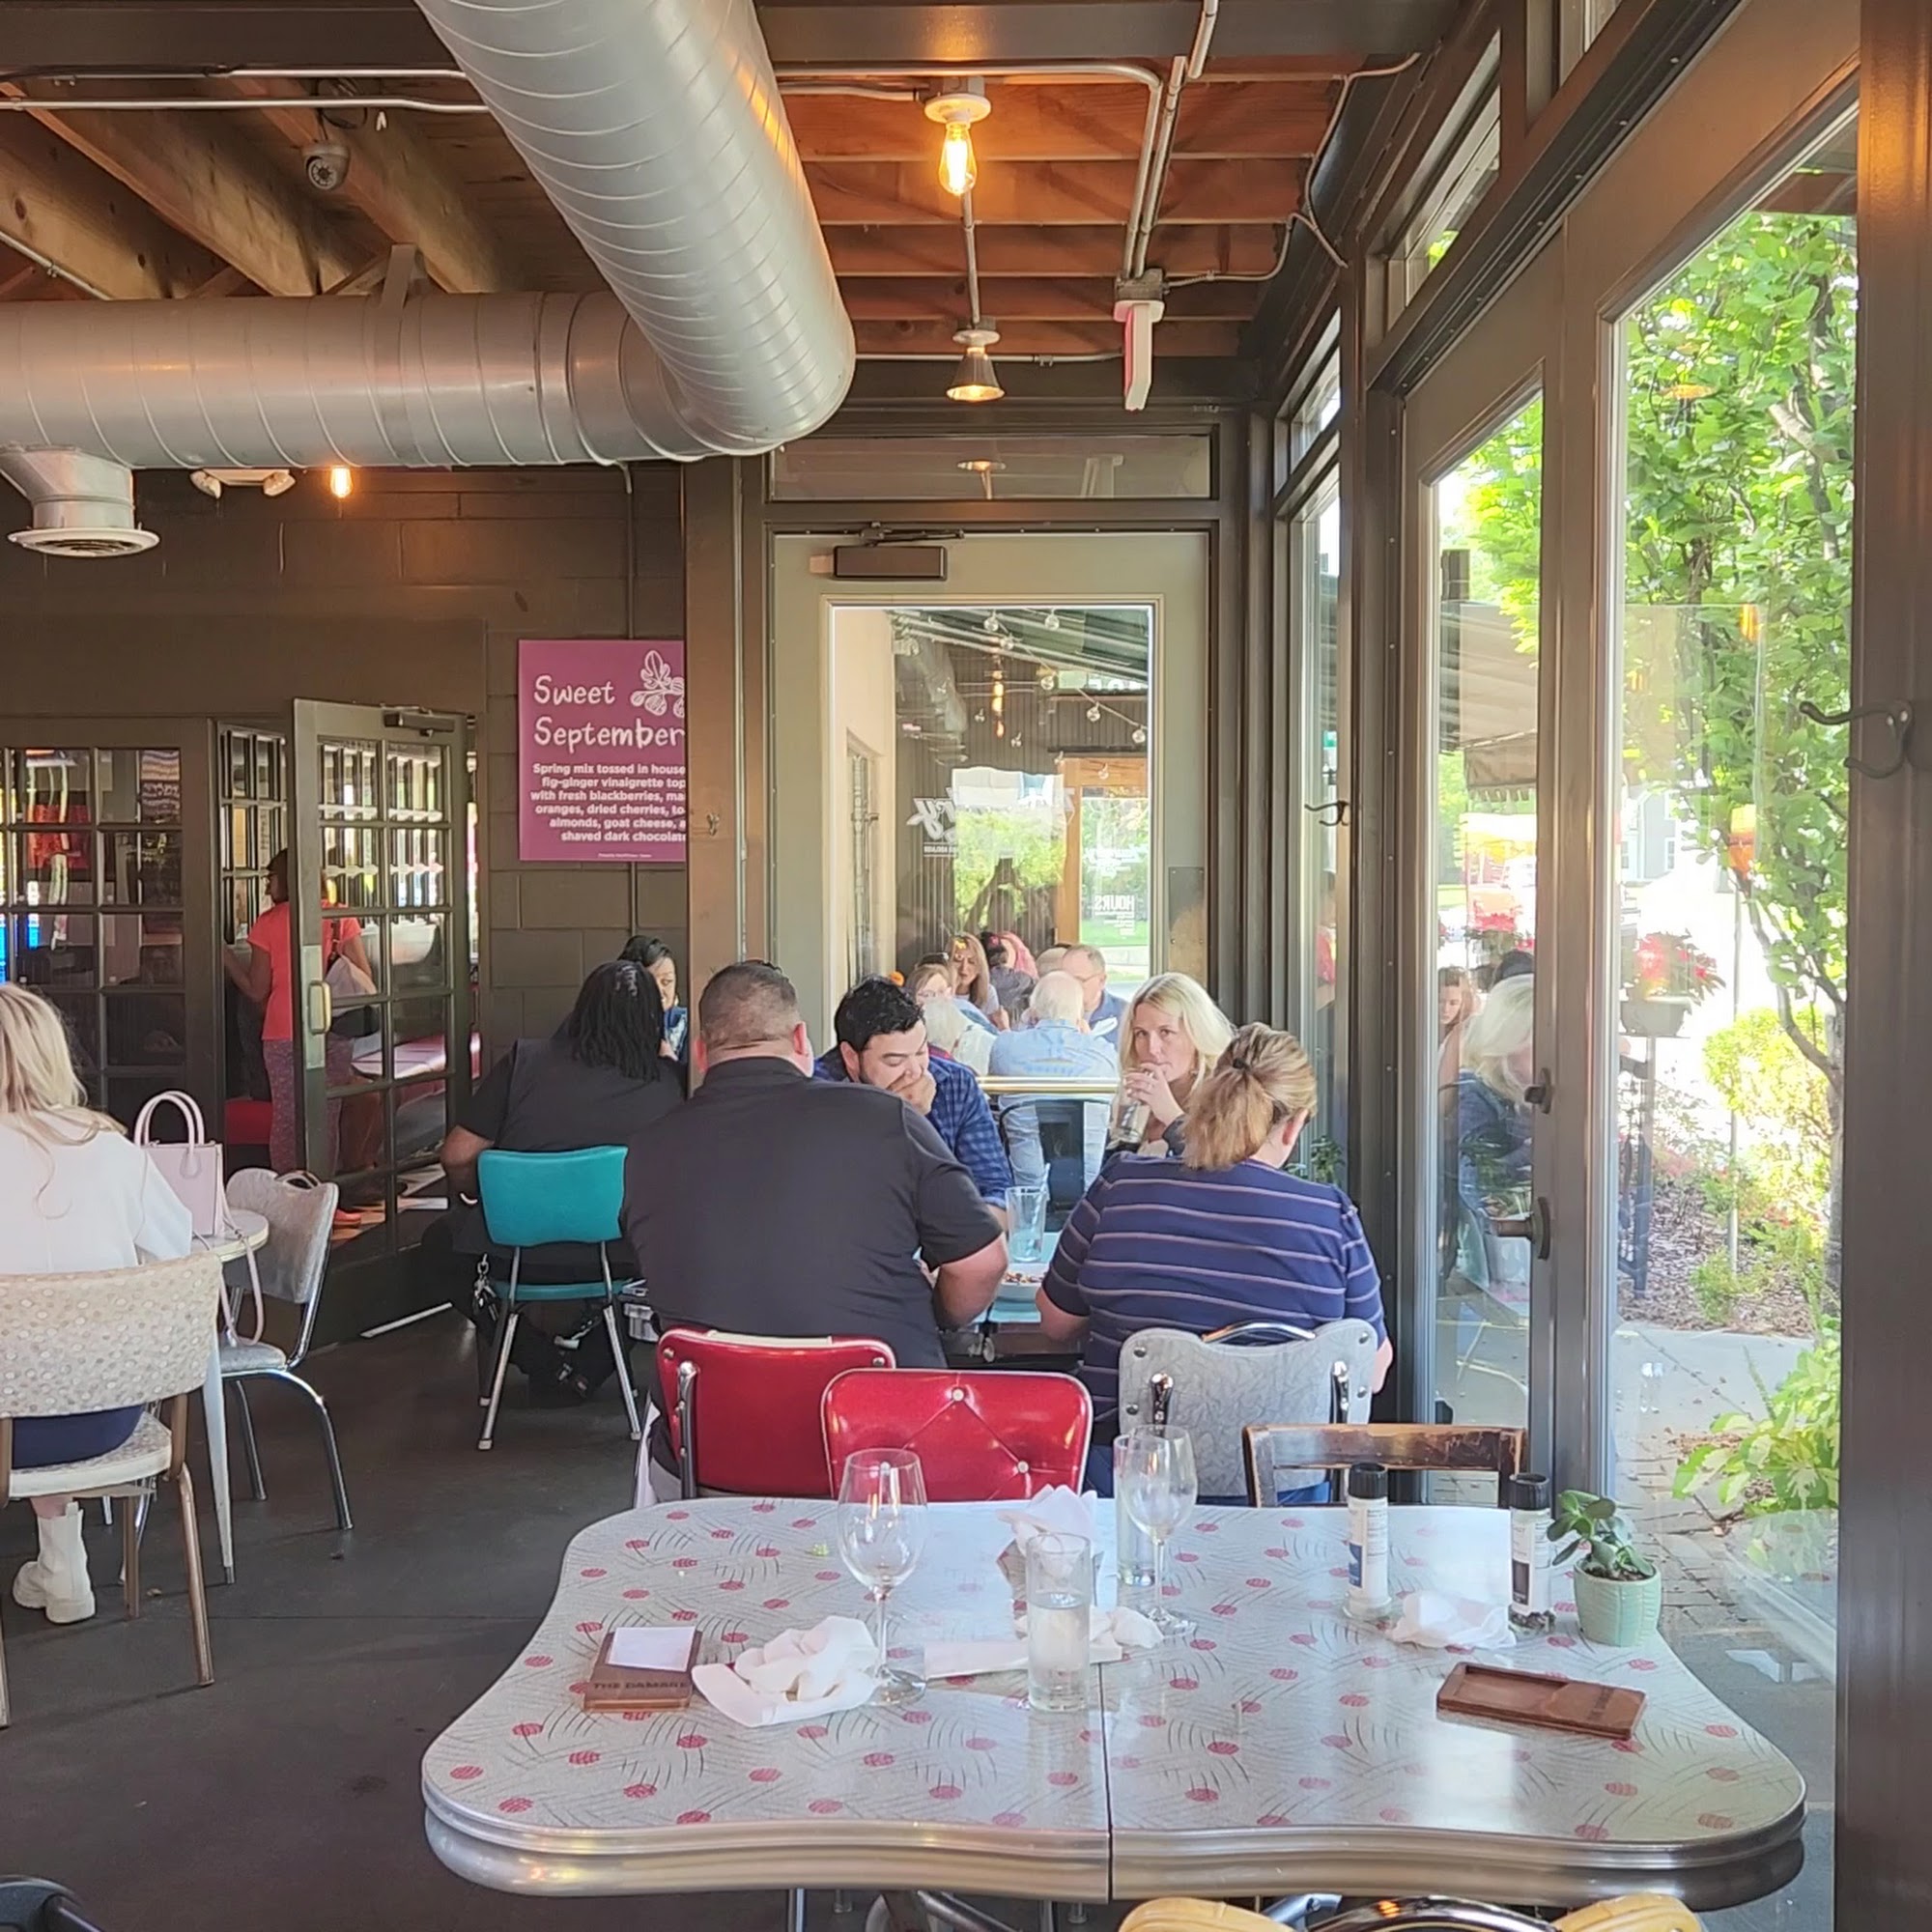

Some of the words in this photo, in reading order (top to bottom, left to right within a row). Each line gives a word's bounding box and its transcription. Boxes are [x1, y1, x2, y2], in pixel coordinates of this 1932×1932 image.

[533, 675, 615, 704] Sweet
[533, 716, 685, 753] September
[533, 763, 571, 775] Spring
[573, 763, 594, 774] mix
[597, 763, 635, 774] tossed
[638, 763, 648, 774] in
[542, 777, 598, 788] fig-ginger
[601, 777, 664, 788] vinaigrette
[530, 790, 555, 801] with
[558, 790, 586, 801] fresh
[589, 790, 664, 803] blackberries,
[667, 792, 686, 802] ma
[535, 806, 584, 816] oranges,
[587, 804, 617, 814] dried
[620, 804, 669, 816] cherries,
[671, 805, 686, 814] to
[550, 817, 602, 829] almonds,
[604, 819, 630, 830] goat
[633, 817, 676, 829] cheese,
[561, 831, 602, 841] shaved
[604, 831, 630, 841] dark
